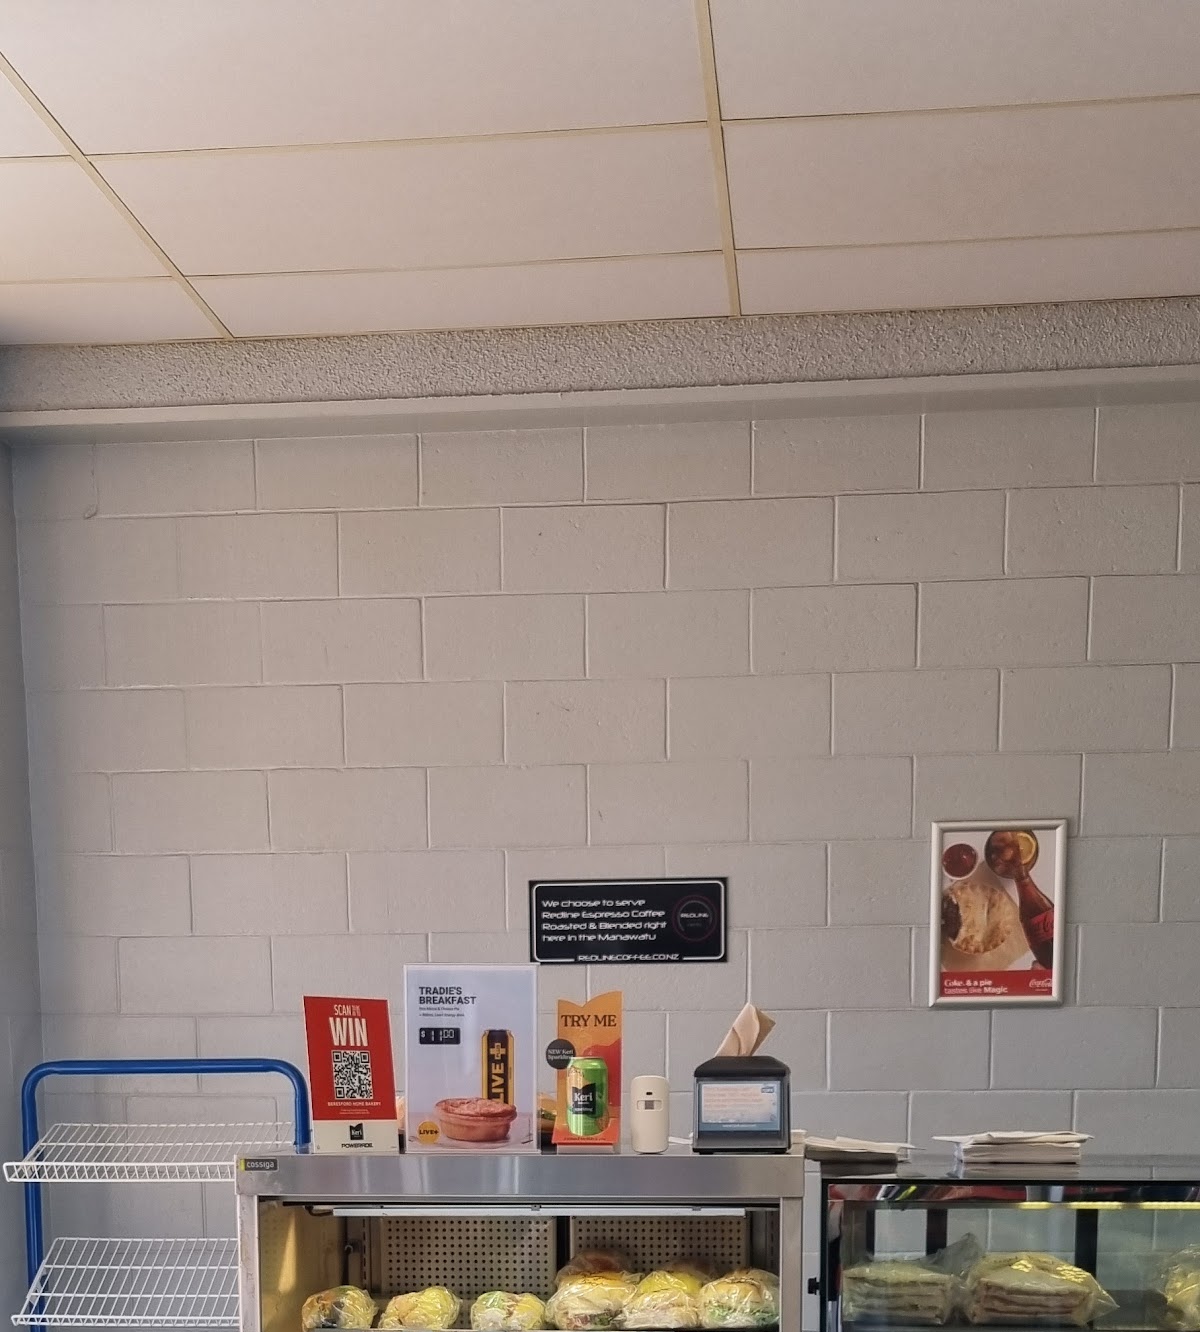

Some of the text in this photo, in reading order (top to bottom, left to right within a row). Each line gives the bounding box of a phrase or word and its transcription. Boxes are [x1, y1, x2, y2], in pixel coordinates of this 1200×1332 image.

[542, 900, 560, 908] We
[561, 900, 601, 908] choose
[615, 899, 646, 907] serve
[542, 909, 666, 919] Redline Espresso Coffee
[542, 921, 668, 931] Roasted & Blended right
[542, 933, 657, 942] here in the Manawatu
[980, 978, 992, 987] pie
[419, 986, 463, 996] TRADIE'S
[983, 986, 1008, 994] Magic
[419, 996, 477, 1005] BREAKFAST
[333, 1004, 352, 1016] SCAN
[561, 1014, 617, 1027] TRY ME
[328, 1016, 369, 1047] WIN
[573, 1092, 593, 1102] Keri
[246, 1161, 275, 1170] cossiga
